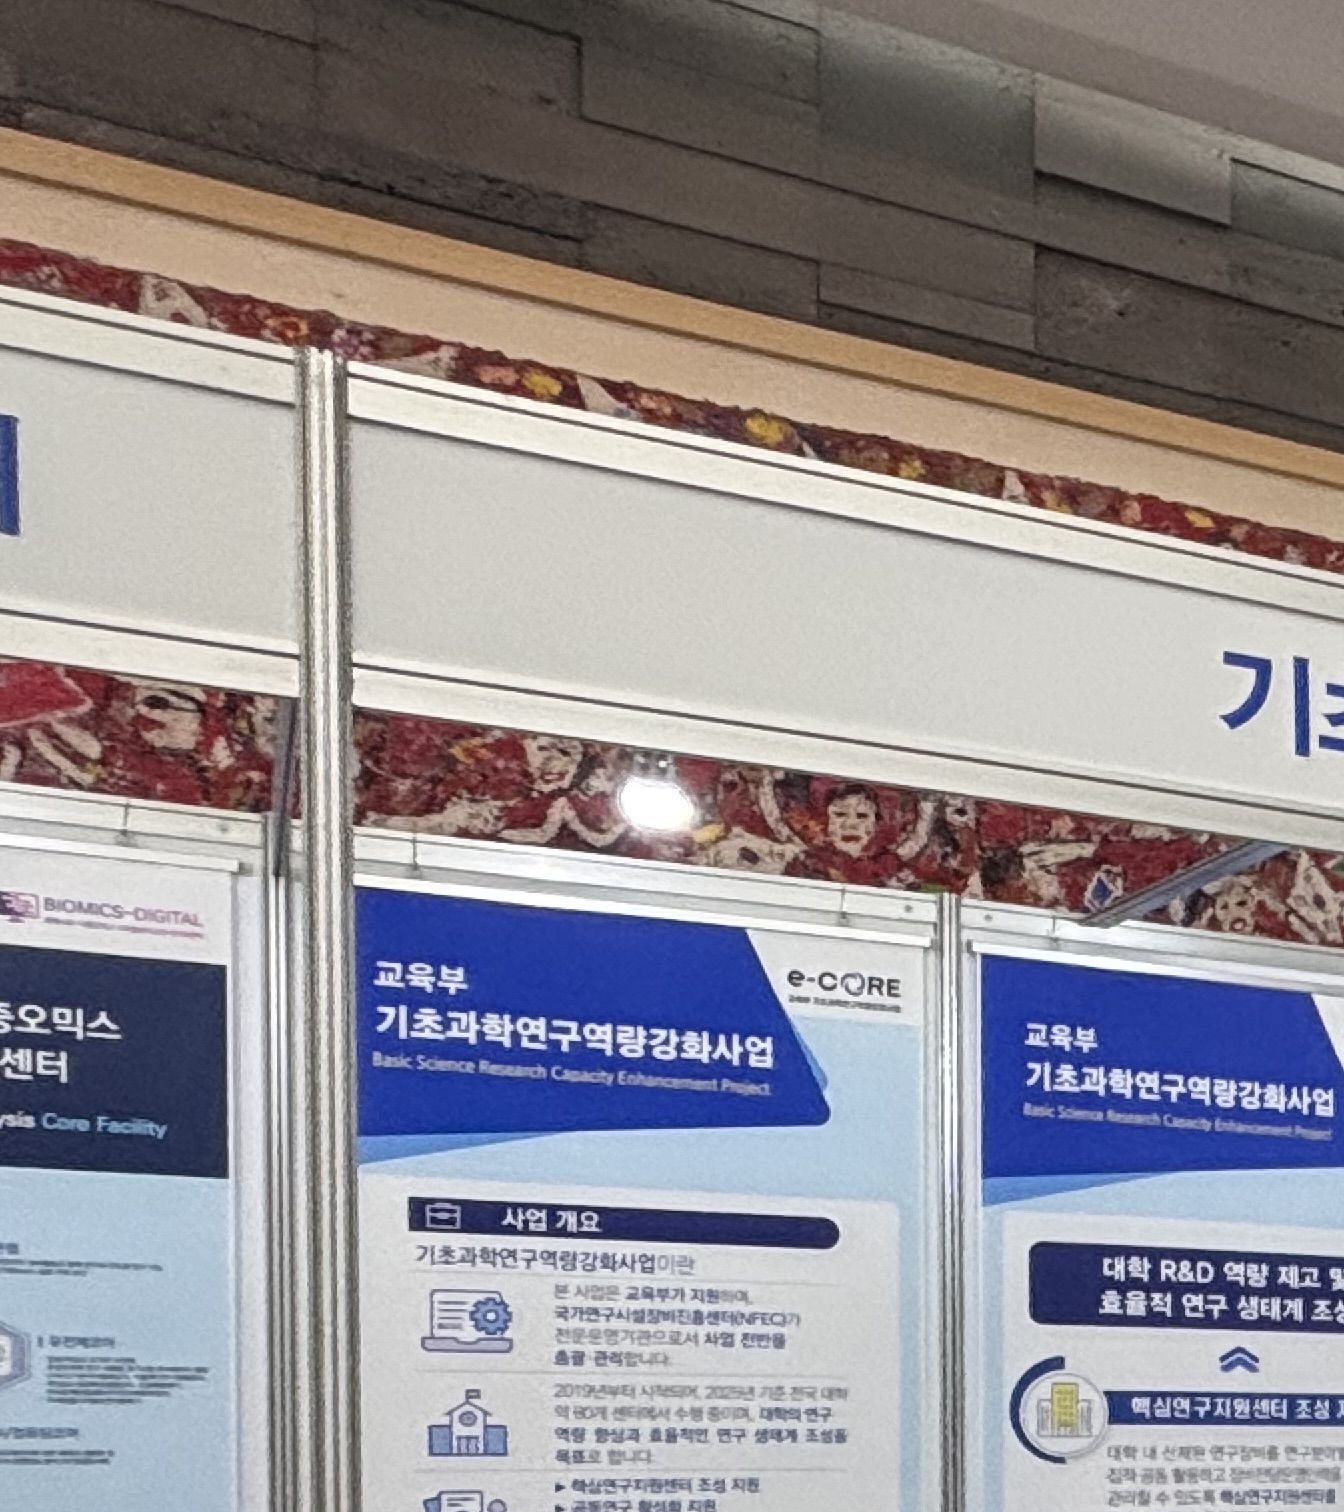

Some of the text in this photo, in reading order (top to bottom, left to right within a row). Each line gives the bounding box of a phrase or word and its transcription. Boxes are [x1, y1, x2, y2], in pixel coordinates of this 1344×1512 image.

[373, 960, 468, 995] 교육부
[787, 968, 902, 998] e-CORE
[375, 1004, 774, 1069] 기초과학연구역량강화사업
[1024, 1022, 1098, 1053] 교육부
[372, 1050, 772, 1097] Basic Science Research Capacity Enhancement Project
[1026, 1061, 1335, 1118] 기초과학연구역량강화사업
[42, 1113, 168, 1139] Core Facility
[502, 1208, 602, 1233] 사업 개요
[1102, 1256, 1151, 1283] 대학
[1161, 1260, 1214, 1284] R&D
[1223, 1260, 1268, 1289] 역량
[1277, 1263, 1322, 1289] 제고
[1099, 1292, 1172, 1318] 효율적
[1182, 1294, 1228, 1319] 연구
[1237, 1295, 1303, 1322] 생태계
[1131, 1395, 1287, 1419] 핵심연구지원센터
[1296, 1399, 1331, 1419] 조성
